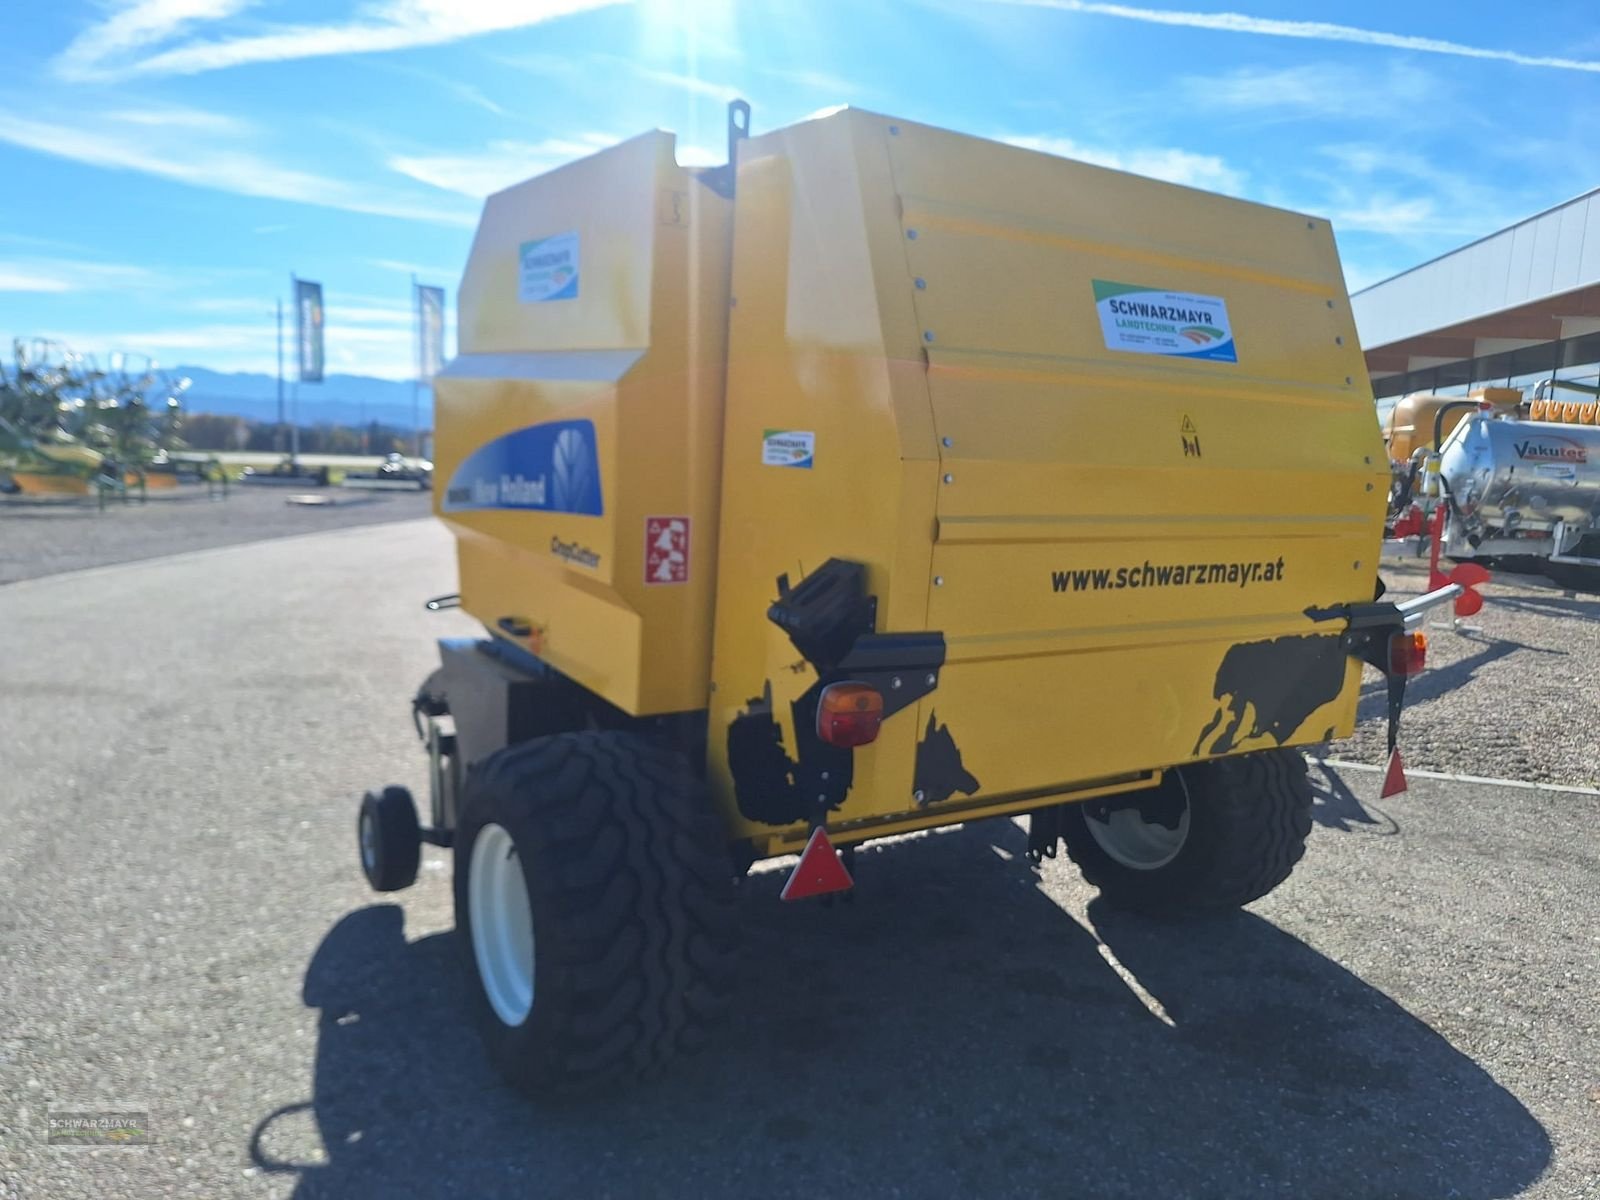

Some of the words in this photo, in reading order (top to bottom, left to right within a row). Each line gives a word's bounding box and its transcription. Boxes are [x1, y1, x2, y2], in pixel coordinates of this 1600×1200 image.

[1109, 299, 1213, 325] SCHWARZMAYR
[1115, 318, 1177, 334] LANDTECHNIK
[1513, 440, 1588, 460] Vakutec
[501, 474, 546, 505] Holland
[551, 535, 600, 569] CropCutter
[1051, 555, 1284, 593] www.schwarzmayr.at
